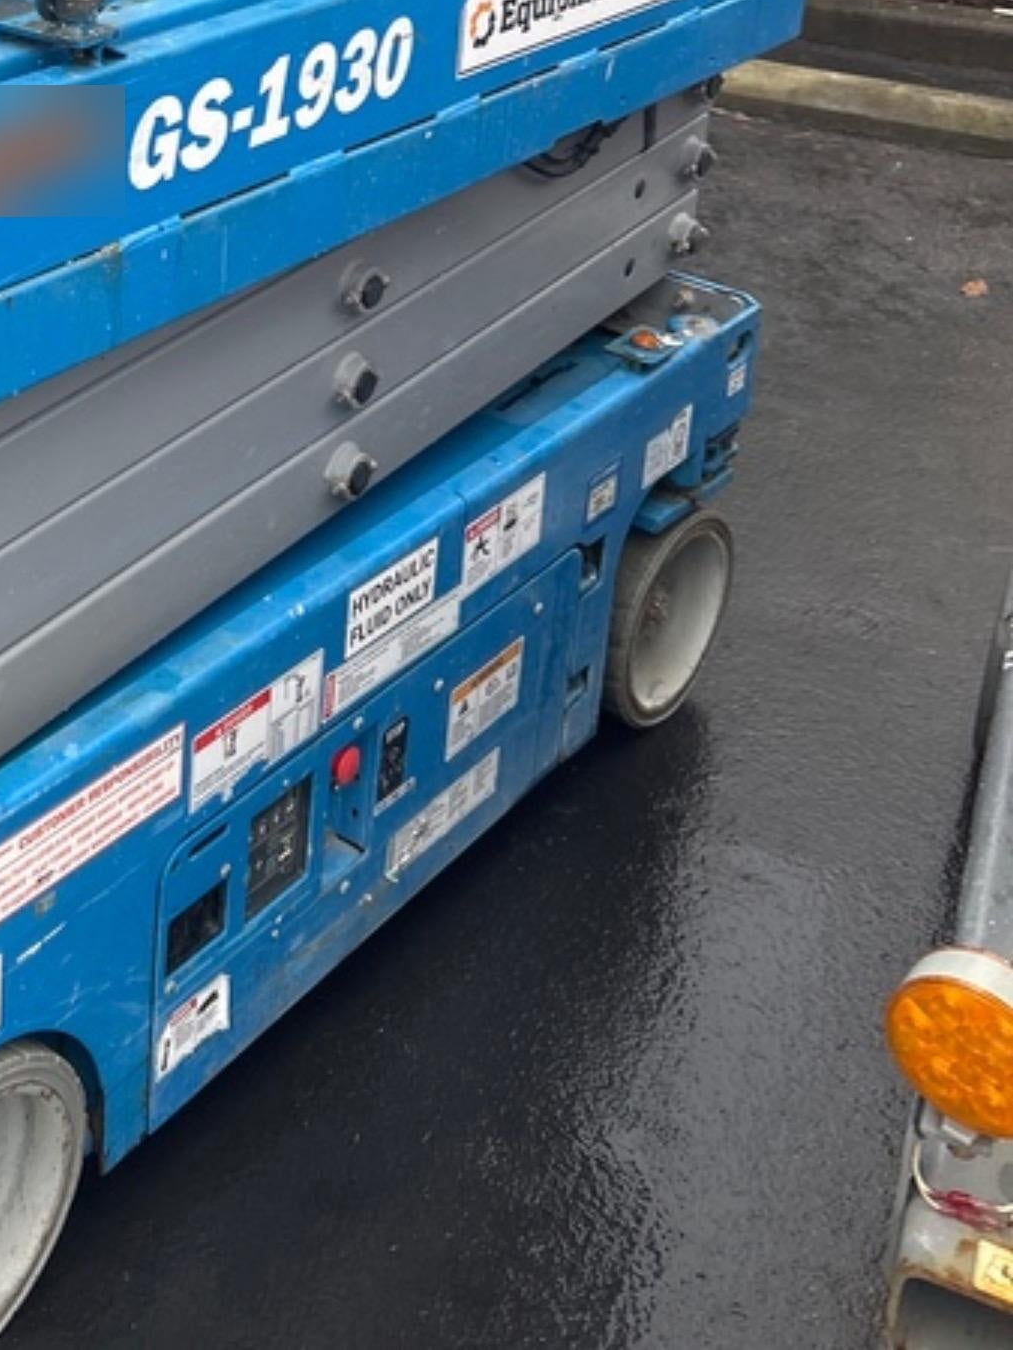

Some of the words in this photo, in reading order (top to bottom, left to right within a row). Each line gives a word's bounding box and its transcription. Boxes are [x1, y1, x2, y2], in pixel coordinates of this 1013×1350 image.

[129, 15, 414, 191] GS-1930
[349, 605, 393, 648] FLUID
[394, 578, 432, 617] ONLY
[352, 548, 435, 618] HYDRAULIC
